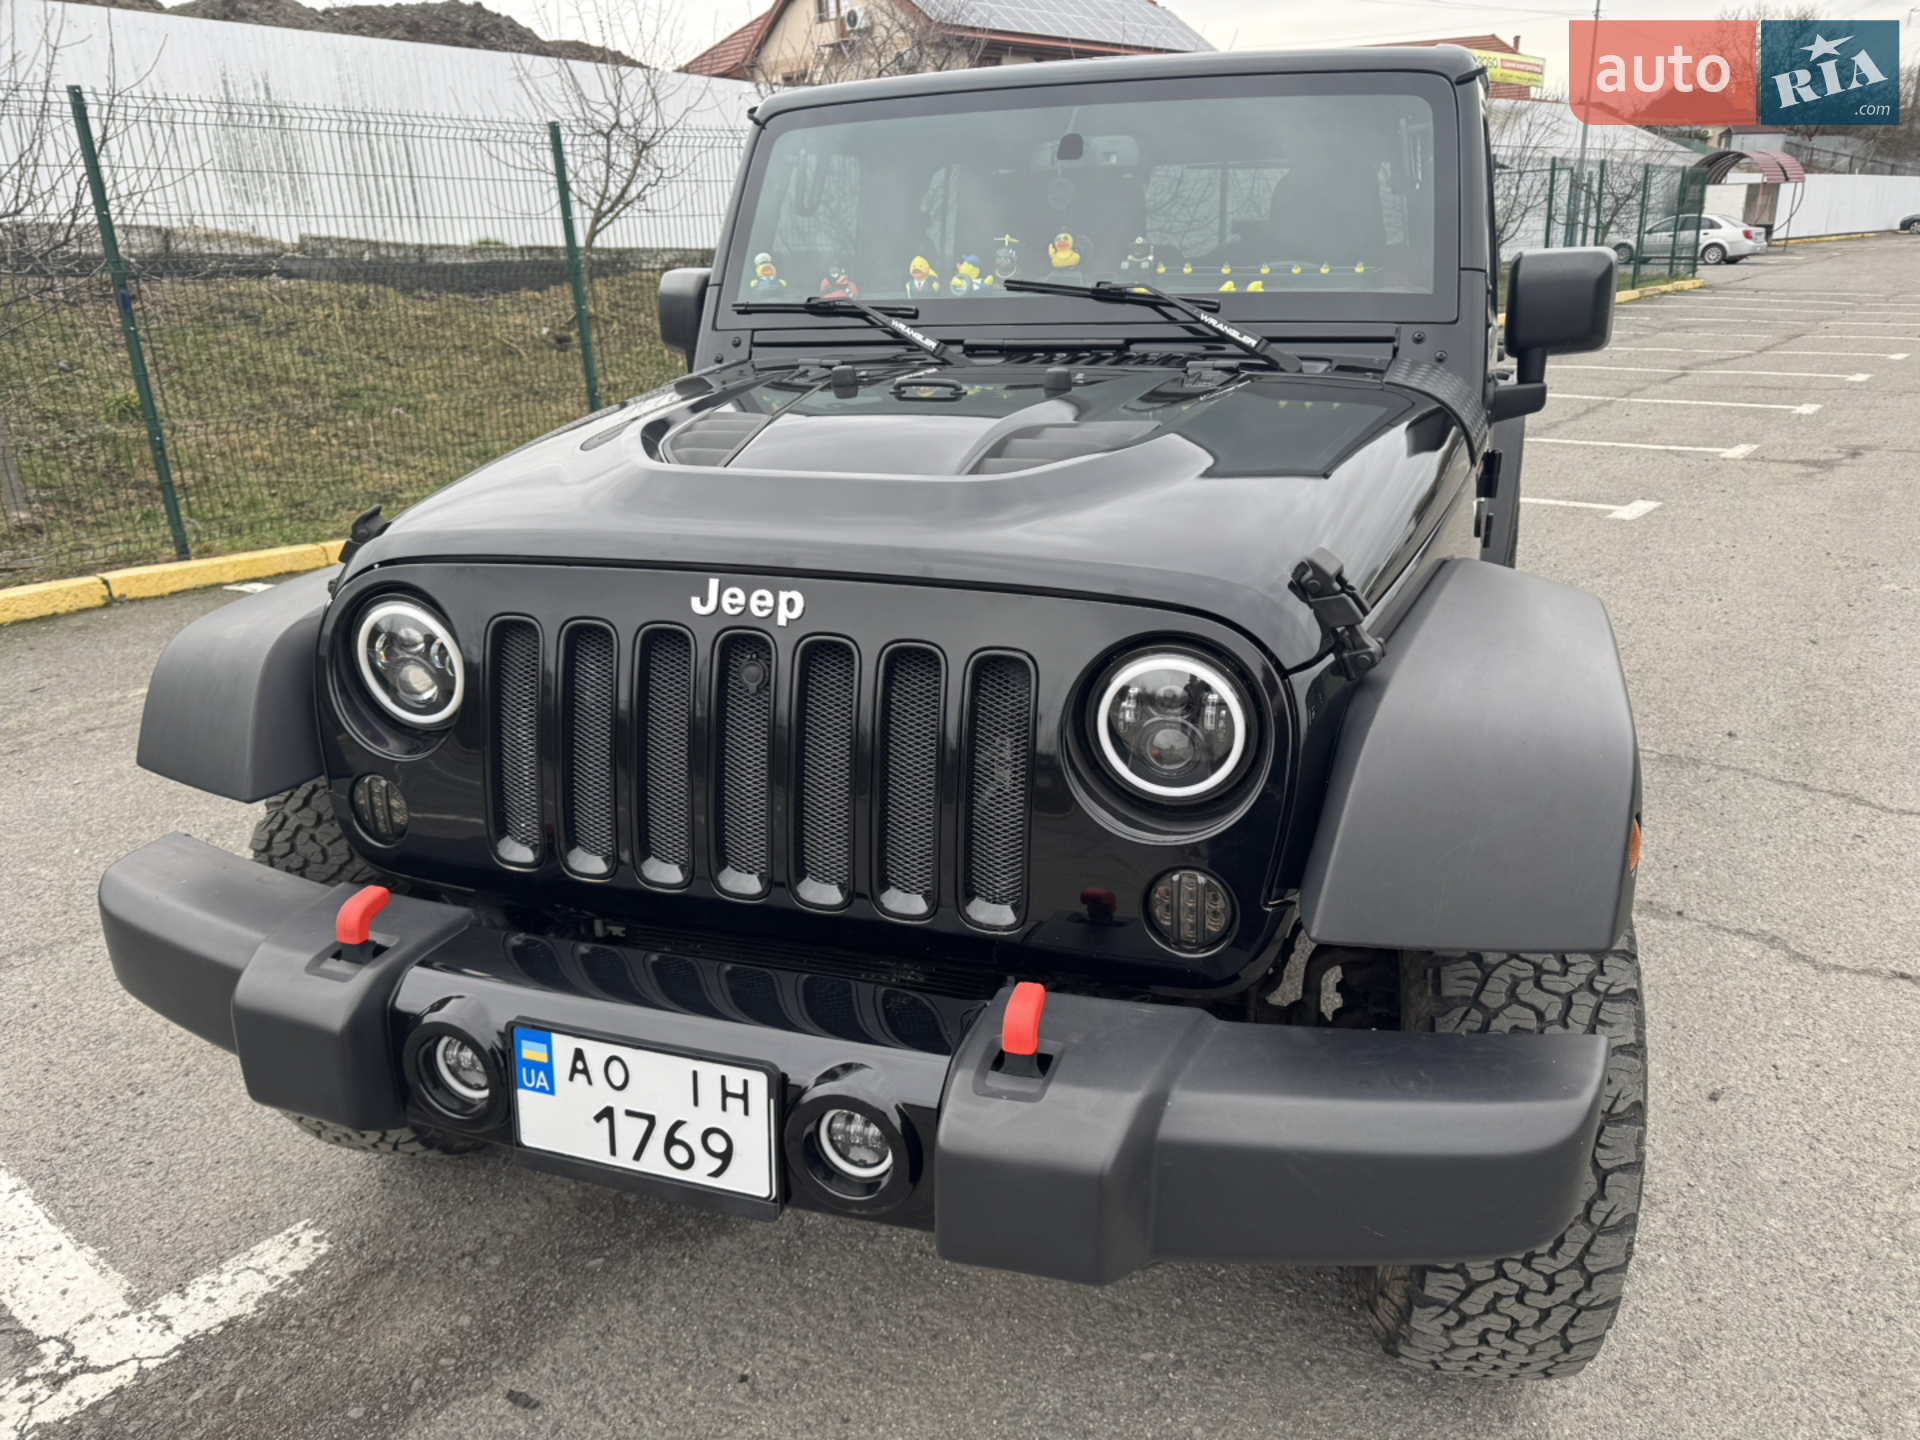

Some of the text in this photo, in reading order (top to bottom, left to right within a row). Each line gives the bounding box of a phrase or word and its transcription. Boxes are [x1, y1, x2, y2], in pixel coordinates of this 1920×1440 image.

[891, 318, 938, 349] WRANGLER
[1200, 312, 1258, 348] WRANGLER
[690, 577, 805, 628] Jeep
[521, 1066, 551, 1092] UA
[568, 1047, 750, 1117] AO IH
[592, 1104, 735, 1179] 1769
